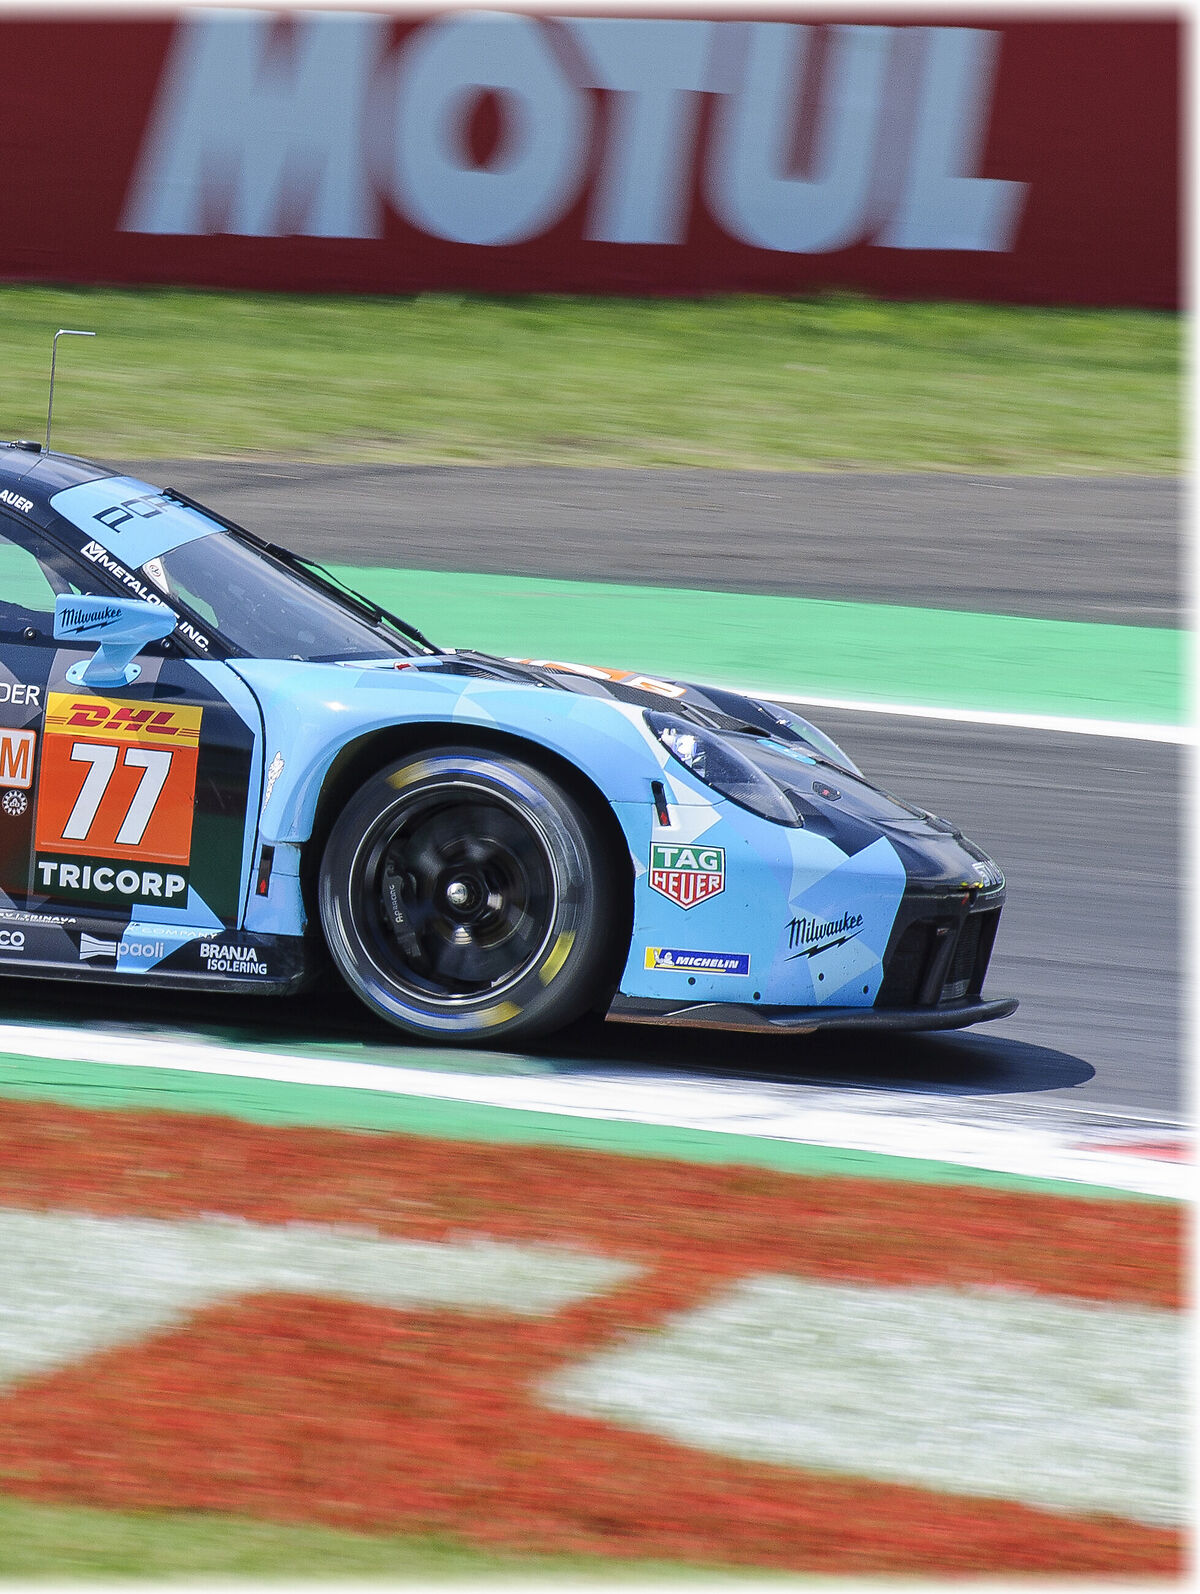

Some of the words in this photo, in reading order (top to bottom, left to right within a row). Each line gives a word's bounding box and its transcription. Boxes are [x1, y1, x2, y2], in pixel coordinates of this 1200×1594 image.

[116, 9, 1032, 254] MOTUL
[58, 606, 123, 628] Milwaukee
[179, 620, 210, 652] INC.
[65, 703, 180, 735] DHL
[60, 741, 175, 846] 77
[657, 847, 719, 871] TAG
[38, 861, 186, 898] TRICORP
[653, 872, 720, 904] HEUER
[784, 911, 864, 949] Milwaukee
[115, 942, 165, 960] paoli
[199, 943, 258, 962] BRANJA
[206, 958, 268, 976] ISOLERING
[675, 955, 739, 969] MICHELIN
